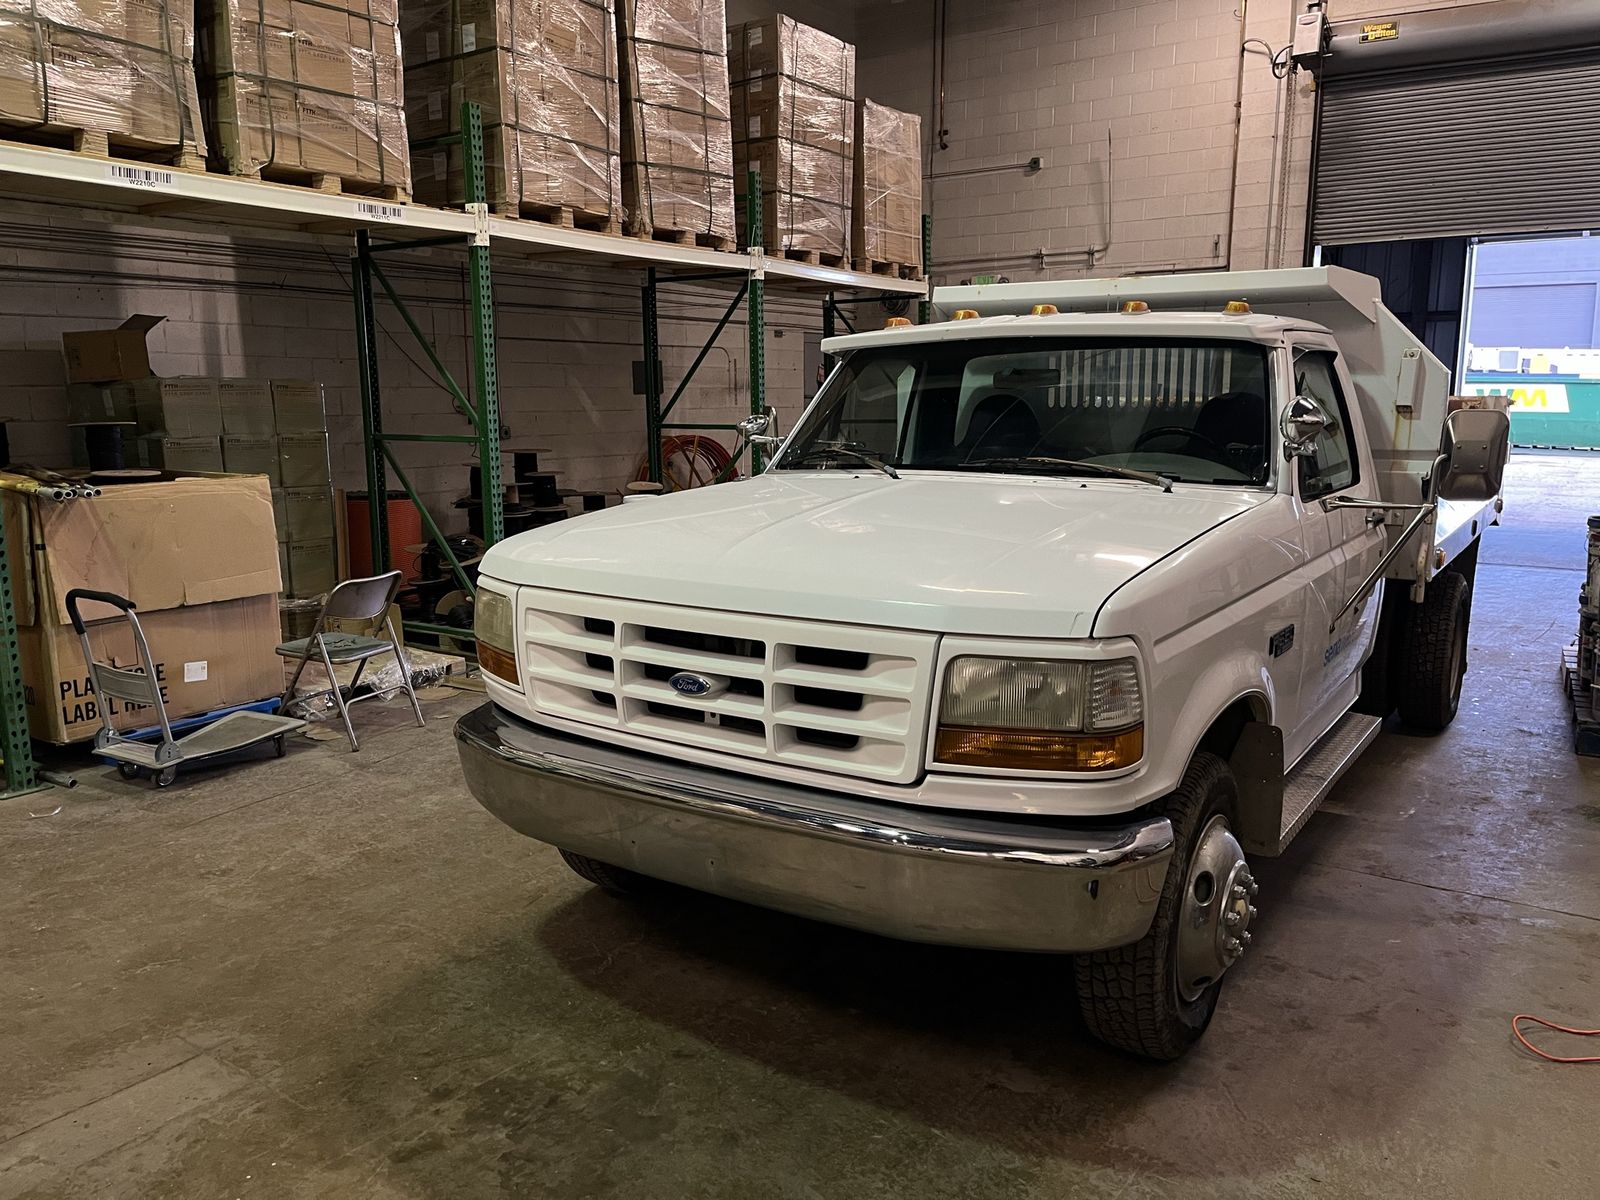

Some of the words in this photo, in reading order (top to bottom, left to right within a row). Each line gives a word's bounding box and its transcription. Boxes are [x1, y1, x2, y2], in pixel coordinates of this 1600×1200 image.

[129, 179, 156, 188] W2210C
[677, 678, 699, 692] Ford
[63, 697, 119, 725] LABL
